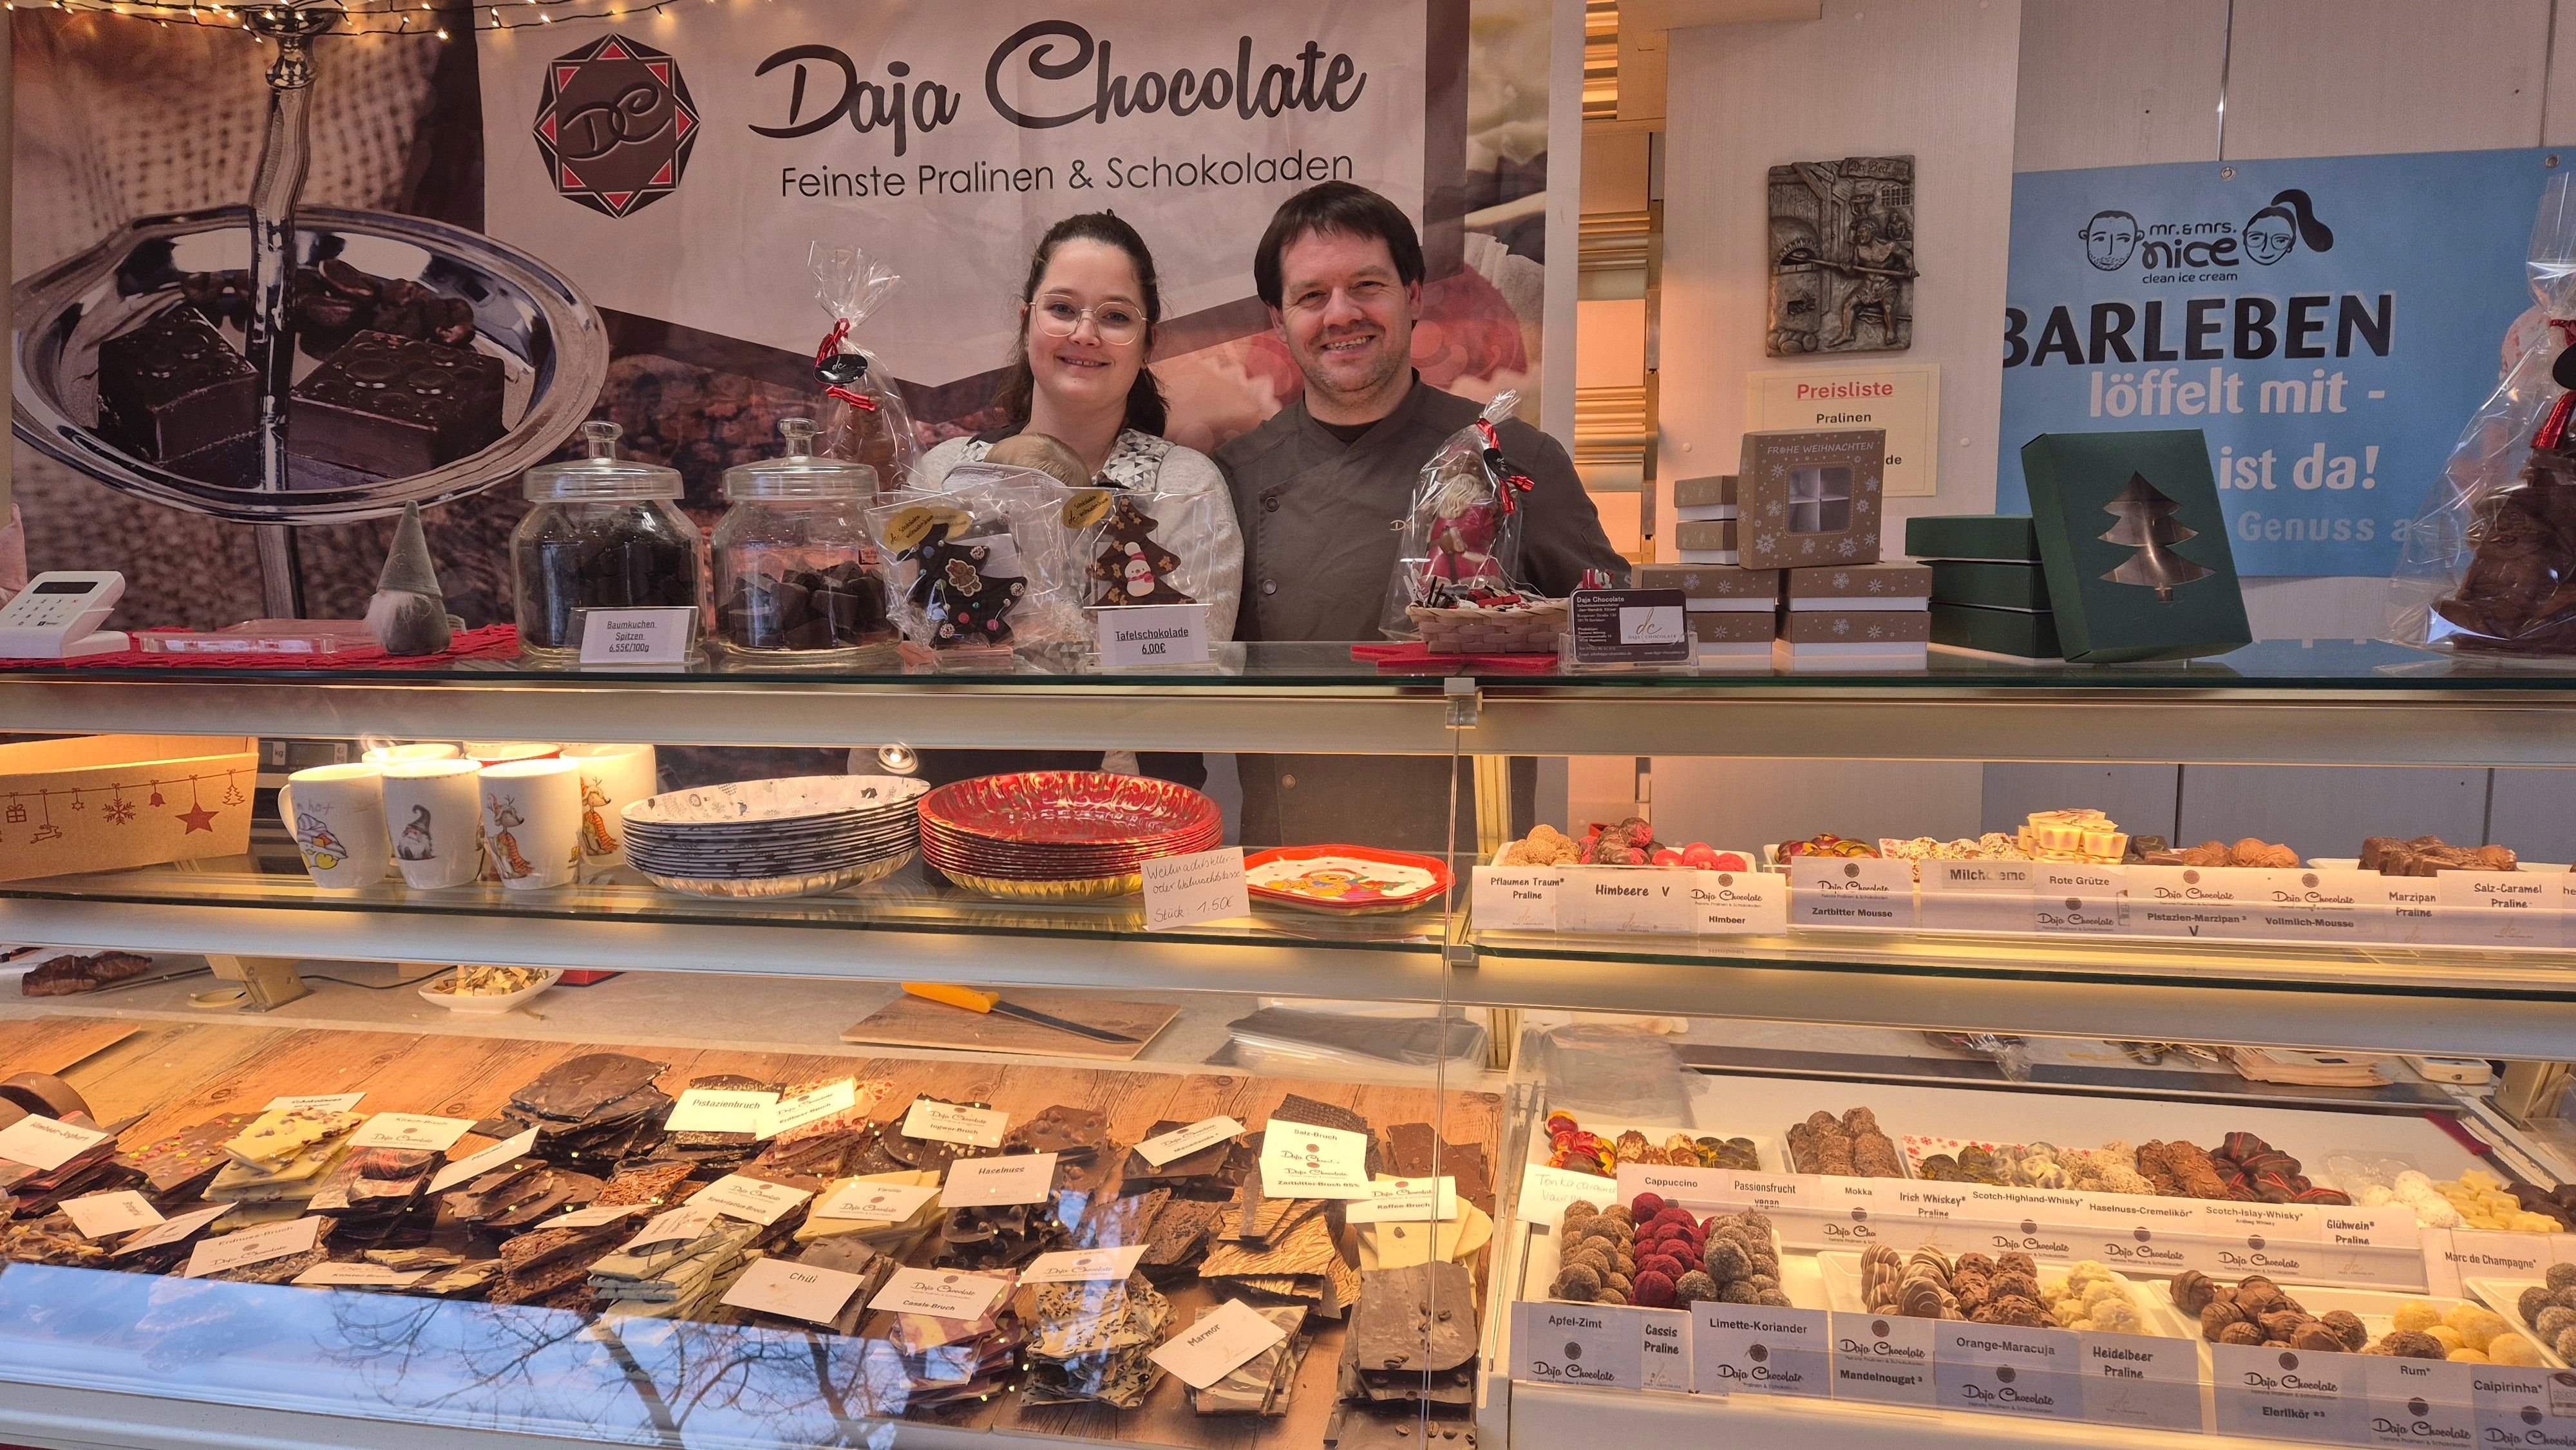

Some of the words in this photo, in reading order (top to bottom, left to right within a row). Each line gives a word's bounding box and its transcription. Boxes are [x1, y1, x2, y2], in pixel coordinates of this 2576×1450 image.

[748, 44, 960, 156] Daja
[985, 20, 1367, 128] Chocolate
[781, 165, 905, 196] Feinste
[919, 158, 1054, 194] Pralinen
[1069, 158, 1094, 187] &
[1106, 149, 1353, 187] Schokoladen
[2142, 237, 2239, 269] nice
[2143, 272, 2175, 284] clean
[2178, 272, 2197, 283] ice
[2199, 272, 2237, 282] cream
[2002, 294, 2391, 368] BARLEBEN
[1797, 382, 1893, 400] Preisliste
[2090, 366, 2244, 417] löffelt
[2260, 369, 2348, 413] mit
[1816, 413, 1871, 424] Pralinen
[1803, 442, 1875, 453] WEIHNACHTEN
[2219, 446, 2277, 490] ist
[2293, 442, 2380, 490] da!
[2238, 511, 2374, 541] Genuss
[607, 621, 655, 629] Baumkuchen
[615, 632, 643, 641] Spitzen
[1115, 627, 1189, 641] Tafelschokolade
[275, 749, 283, 757] kg
[1491, 878, 1529, 886] Pflaumen
[2050, 876, 2072, 884] Rote
[2076, 876, 2109, 886] Grütze
[1153, 882, 1175, 894] oder
[1596, 884, 1649, 896] Himbeere
[1662, 887, 1670, 897] V
[2154, 887, 2183, 899] Daja
[2186, 888, 2235, 899] Chocolate
[2474, 883, 2542, 894] Salz-Caramel
[1690, 889, 1716, 900] Daja
[1719, 890, 1762, 901] Chocolate
[2272, 891, 2302, 903] Daja
[2304, 891, 2354, 903] Chocolate
[2389, 892, 2436, 904] Marzipan
[2492, 898, 2528, 908] Praline
[1812, 908, 1855, 917] Zartbitter
[1858, 909, 1892, 918] Mousse
[2037, 912, 2064, 925] Daja
[2067, 914, 2114, 925] Chocolate
[2148, 913, 2239, 923] Pistazien-Marzipan
[2396, 907, 2432, 918] Praline
[1709, 916, 1745, 924] Himbeer
[2266, 917, 2354, 928] Vollmilch-Mousse
[2189, 925, 2199, 936] V
[692, 1098, 761, 1109] Pistazienbruch
[931, 1124, 978, 1135] Ingwer-Bruch
[1294, 1129, 1338, 1140] Salz-Bruch
[978, 1166, 1025, 1175] Haselnuss
[1645, 1176, 1698, 1188] Cappuccino
[1734, 1181, 1796, 1194] Passionsfrucht
[1845, 1187, 1873, 1196] Mokka
[1900, 1192, 1920, 1203] Irish
[708, 1196, 766, 1214] Spekulatius-Bruch
[1754, 1198, 1779, 1209] vegan
[1918, 1208, 1949, 1219] Praline
[1823, 1223, 1851, 1238] Daja
[1992, 1236, 2020, 1249] Daja
[2023, 1238, 2069, 1252] Chocolate
[2335, 1236, 2370, 1245] Praline
[2104, 1243, 2134, 1258] Daja
[2136, 1245, 2184, 1261] Chocolate
[2445, 1252, 2468, 1263] Marc
[2470, 1254, 2480, 1263] de
[2219, 1251, 2248, 1266] Daja
[2251, 1254, 2300, 1269] Chocolate
[789, 1272, 819, 1284] Chili
[903, 1300, 955, 1311] Cassis-Bruch
[1548, 1315, 1602, 1330] Apfel-Zimt
[1710, 1318, 1808, 1334] Limette-Koriander
[1186, 1322, 1221, 1347] Marmor
[1645, 1324, 1678, 1339] Cassis
[1643, 1341, 1679, 1355] Praline
[1839, 1339, 1870, 1355] Daja
[1873, 1341, 1926, 1358] Chocolate
[1956, 1337, 2055, 1355] Orange-Maracuja
[2093, 1346, 2154, 1362] Heidelbeer
[1533, 1361, 1562, 1377] Daja
[1565, 1364, 1615, 1382] Chocolate
[1717, 1364, 1748, 1380] Daja
[1751, 1366, 1803, 1382] Chocolate
[1840, 1370, 1915, 1385] Mandelnougat
[2104, 1365, 2144, 1380] Praline
[2244, 1372, 2277, 1389] Daja
[2281, 1375, 2338, 1393] Chocolate
[1962, 1384, 1995, 1401] Daja
[1998, 1387, 2054, 1406] Chocolate
[2262, 1406, 2309, 1419] Eierlikör
[2372, 1418, 2408, 1435] Daja
[2411, 1421, 2472, 1440] Chocolate
[2485, 1427, 2522, 1447] Daja
[2525, 1430, 2576, 1447] Chocola
